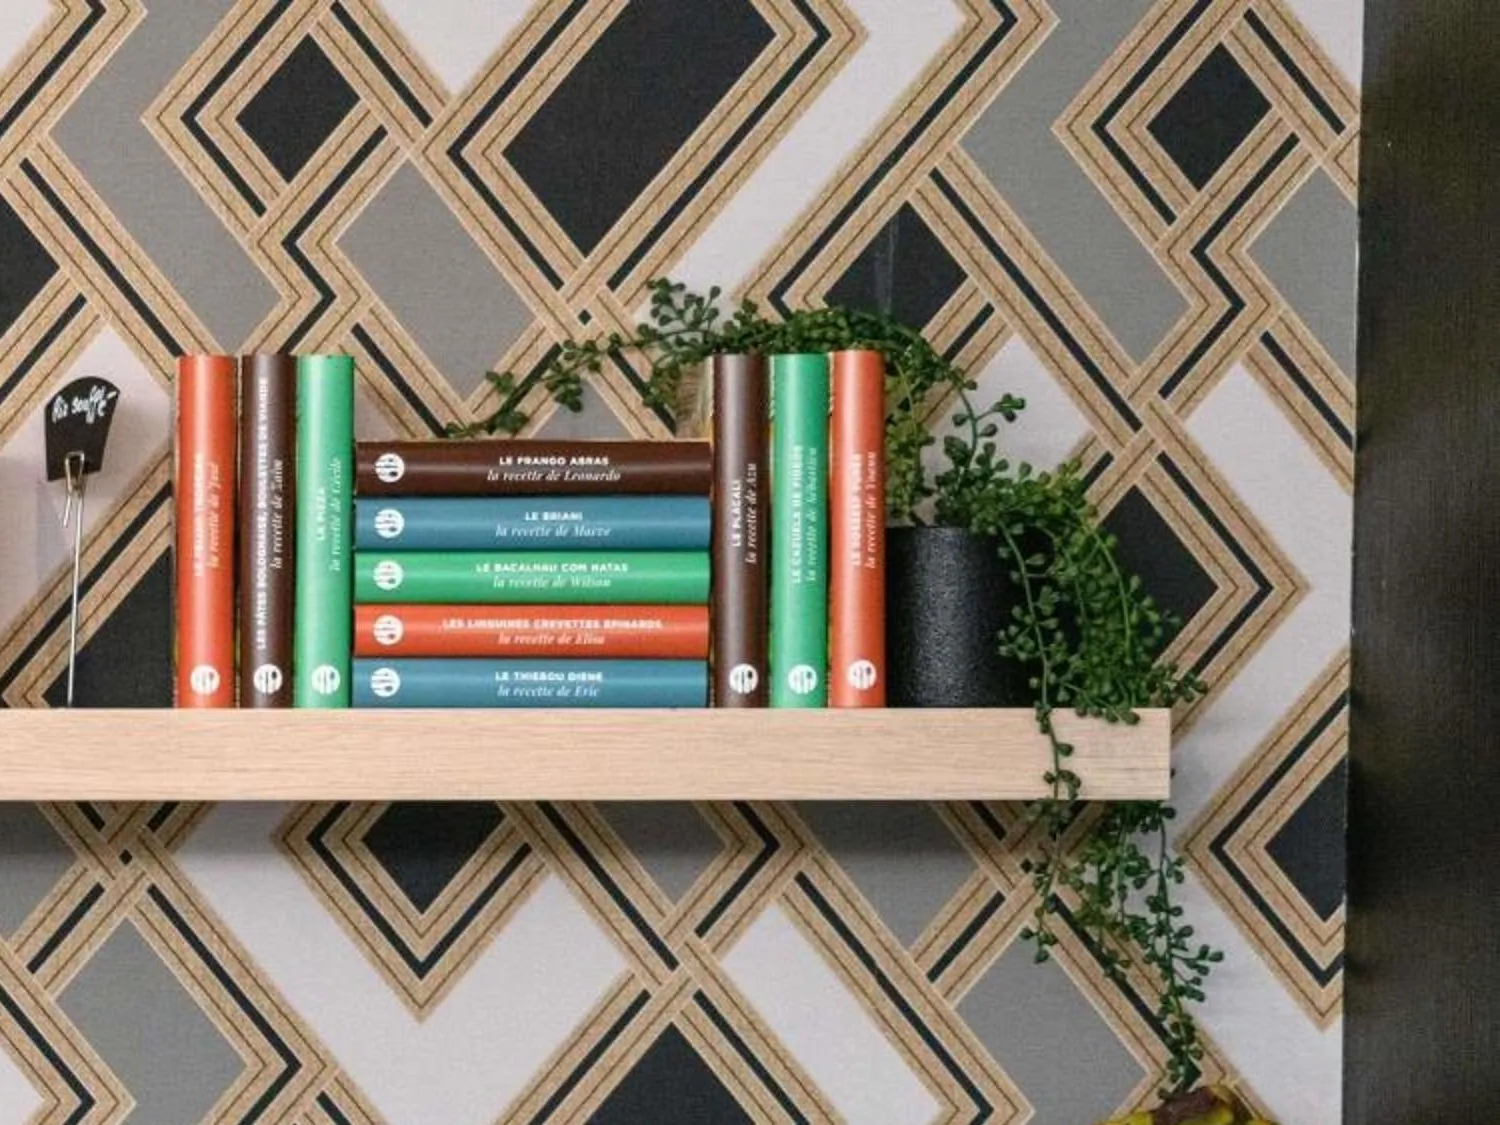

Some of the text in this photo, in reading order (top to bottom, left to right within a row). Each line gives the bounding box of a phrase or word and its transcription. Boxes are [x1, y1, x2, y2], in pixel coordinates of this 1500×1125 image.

[499, 457, 514, 466] LE
[487, 469, 499, 482] la
[503, 469, 543, 482] recette
[546, 469, 560, 482] de
[525, 512, 539, 522] LE
[495, 523, 508, 538] la
[511, 523, 553, 538] recette
[555, 523, 569, 538] de
[475, 563, 489, 573] LE
[493, 575, 504, 589] la
[508, 575, 548, 589] recette
[551, 575, 567, 589] de
[498, 633, 510, 645] la
[513, 633, 554, 645] recette
[557, 633, 571, 645] de
[495, 671, 510, 682] LE
[497, 684, 509, 698] la
[512, 684, 553, 698] recette
[555, 684, 570, 698] de
